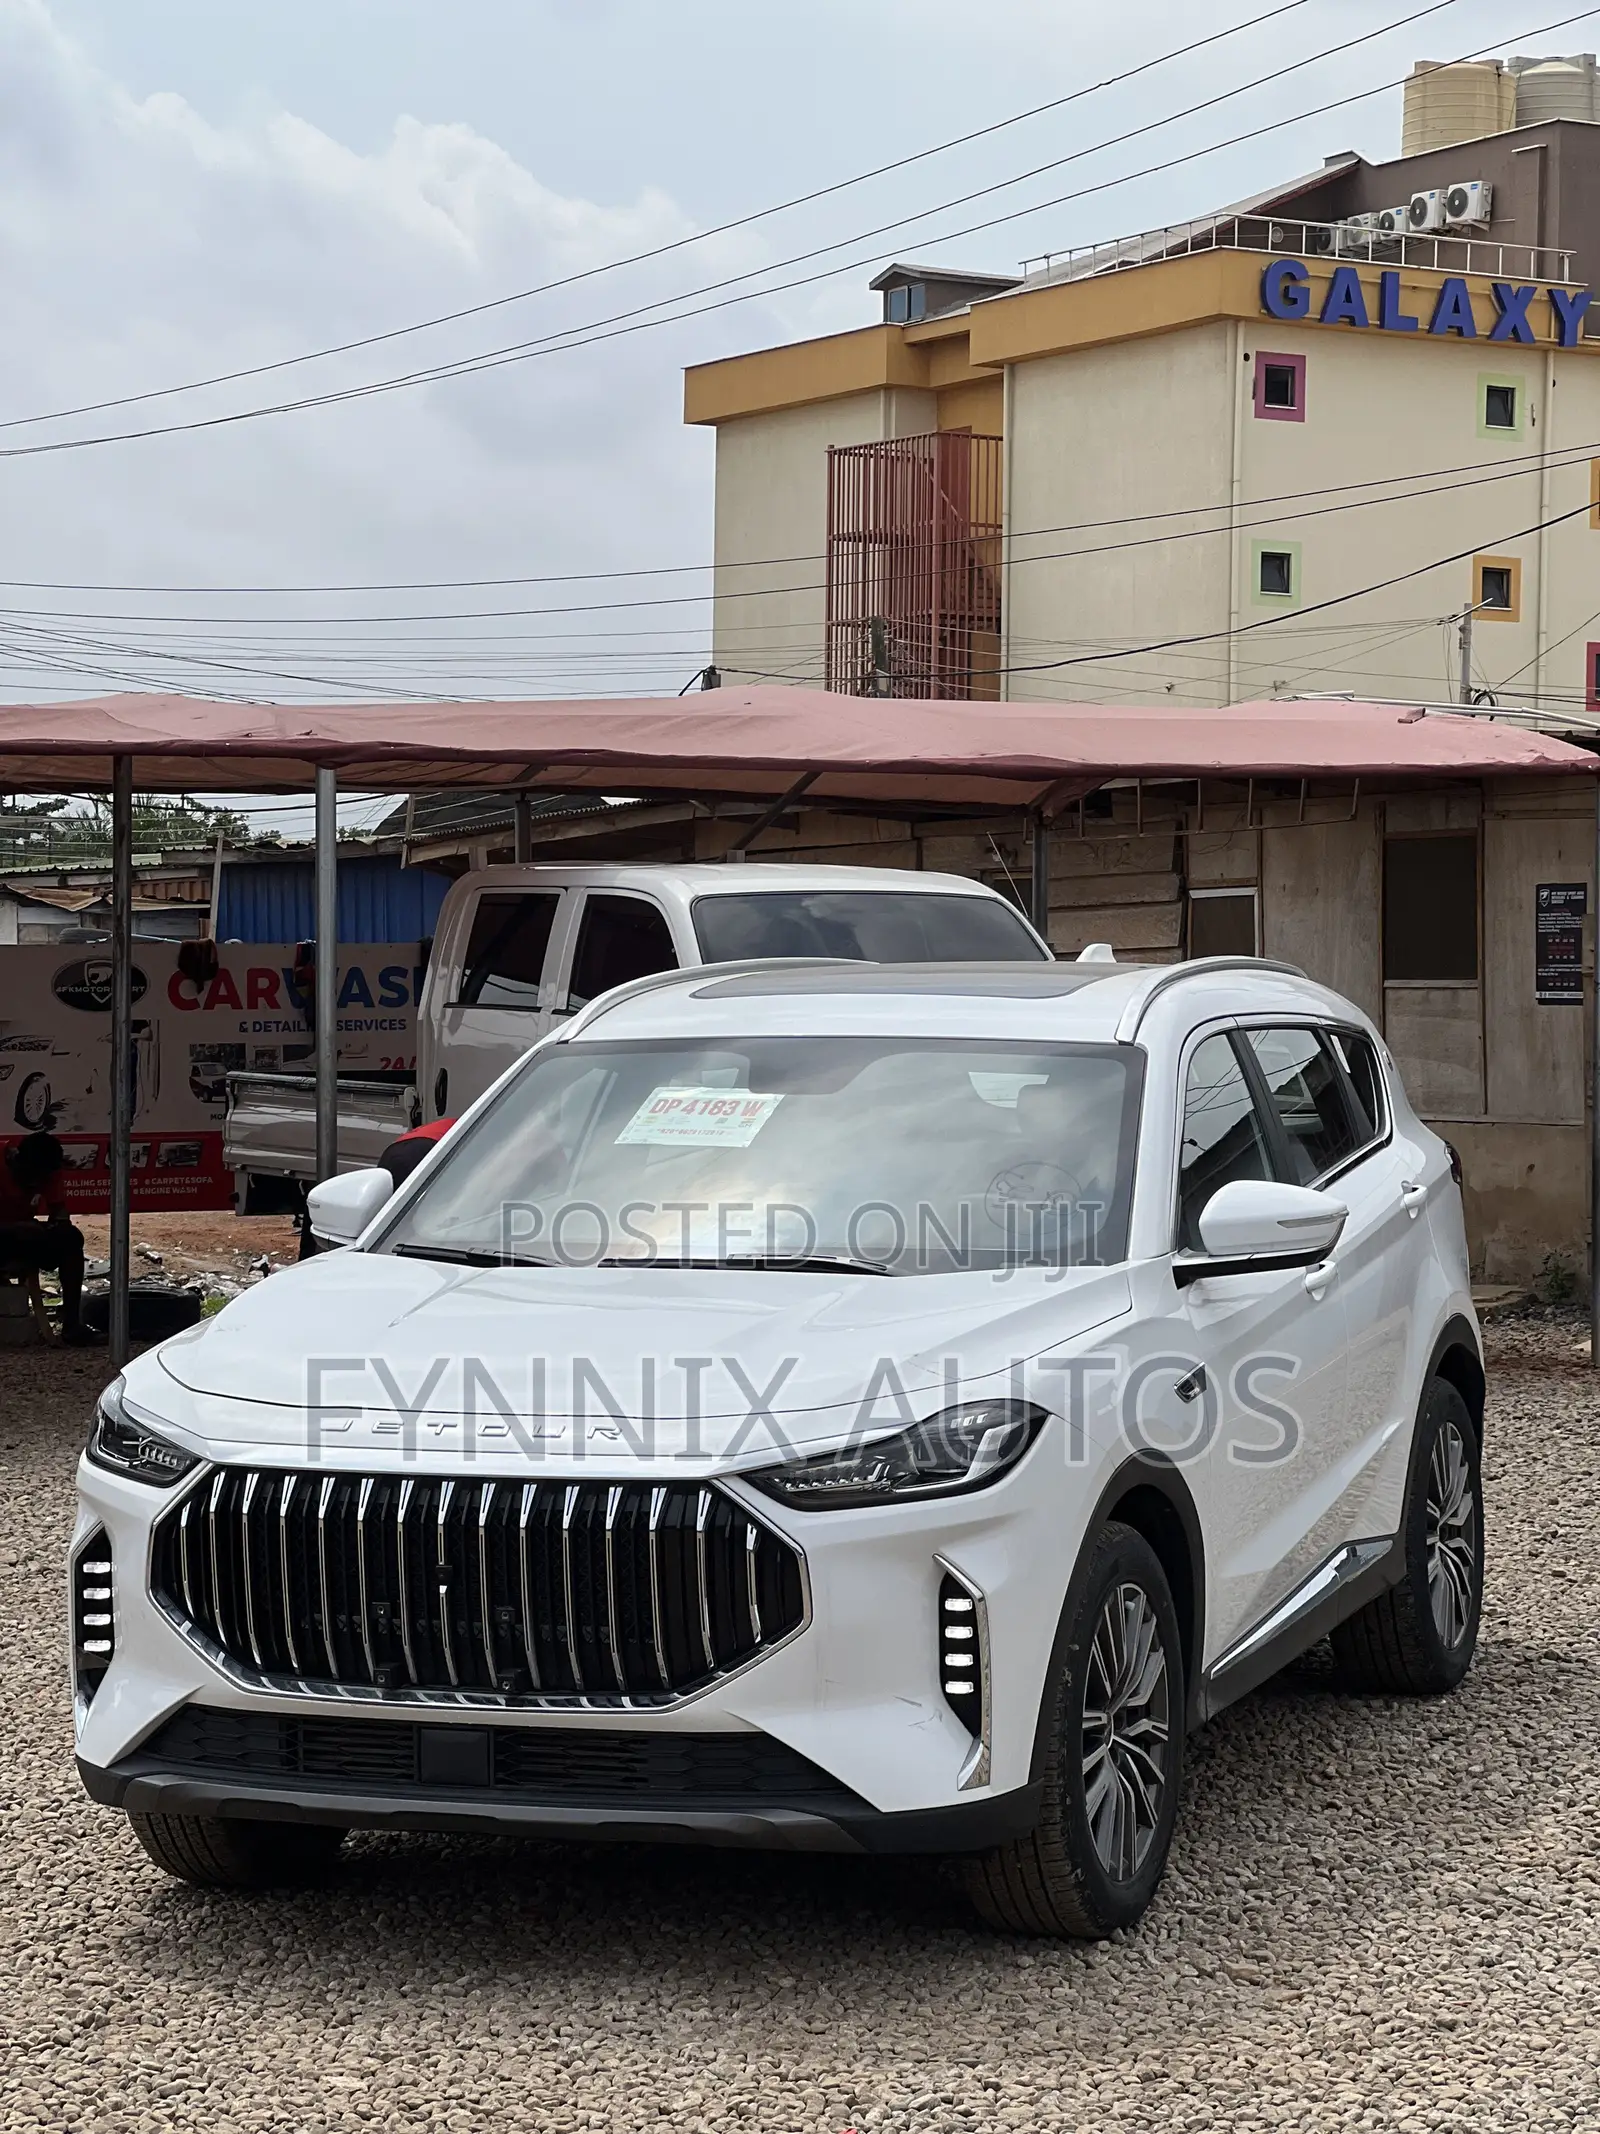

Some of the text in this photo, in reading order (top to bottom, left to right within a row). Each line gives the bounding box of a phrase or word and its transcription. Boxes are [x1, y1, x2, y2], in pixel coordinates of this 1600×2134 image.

[1261, 258, 1593, 347] GALAXY
[238, 1021, 249, 1033] &
[336, 1019, 407, 1032] SERVICES
[649, 1099, 766, 1117] DP 4183 W
[320, 1418, 624, 1441] JETOUR
